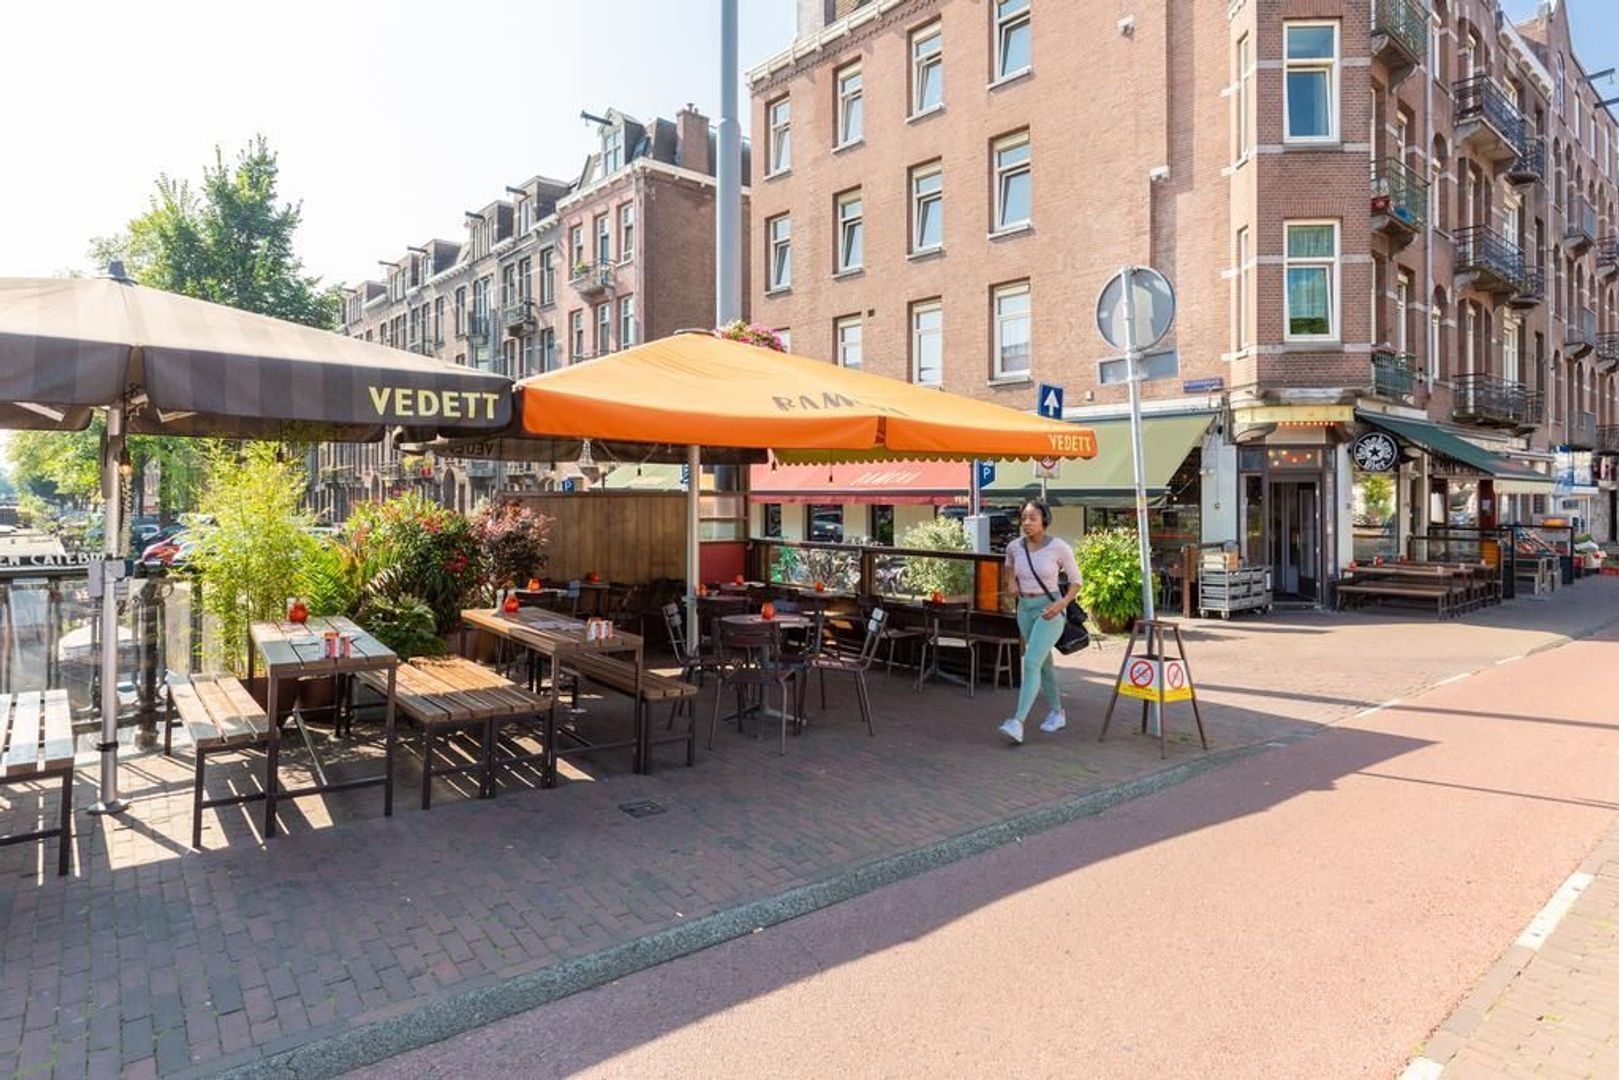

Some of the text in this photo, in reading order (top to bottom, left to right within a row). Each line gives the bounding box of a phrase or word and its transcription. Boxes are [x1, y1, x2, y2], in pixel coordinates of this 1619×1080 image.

[368, 386, 499, 419] VEDETT
[1048, 434, 1091, 452] VEDETT
[983, 467, 991, 480] P
[564, 480, 572, 491] P
